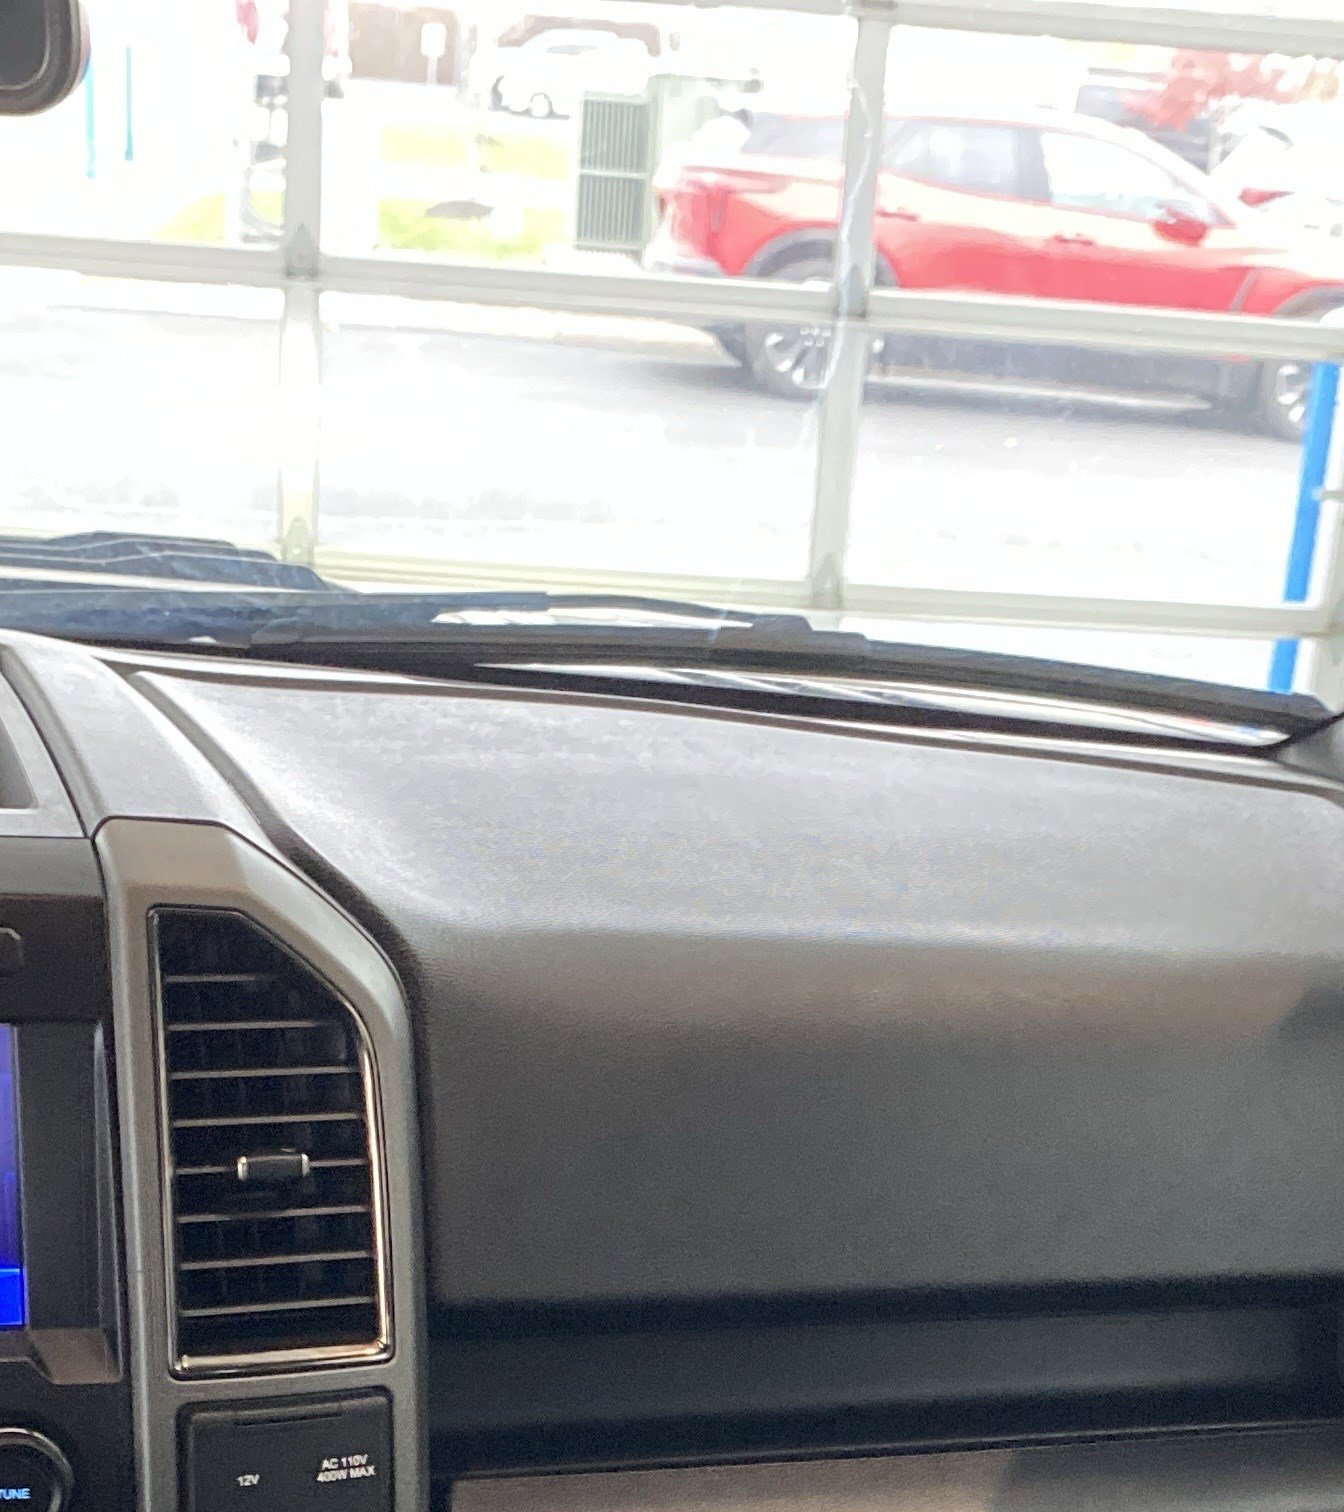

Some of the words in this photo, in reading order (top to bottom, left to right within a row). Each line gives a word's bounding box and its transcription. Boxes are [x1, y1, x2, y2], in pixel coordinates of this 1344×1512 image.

[320, 1456, 339, 1471] AC
[340, 1453, 369, 1469] 110V
[236, 1473, 260, 1487] 12V
[316, 1469, 348, 1482] 400W
[349, 1465, 376, 1478] MAX
